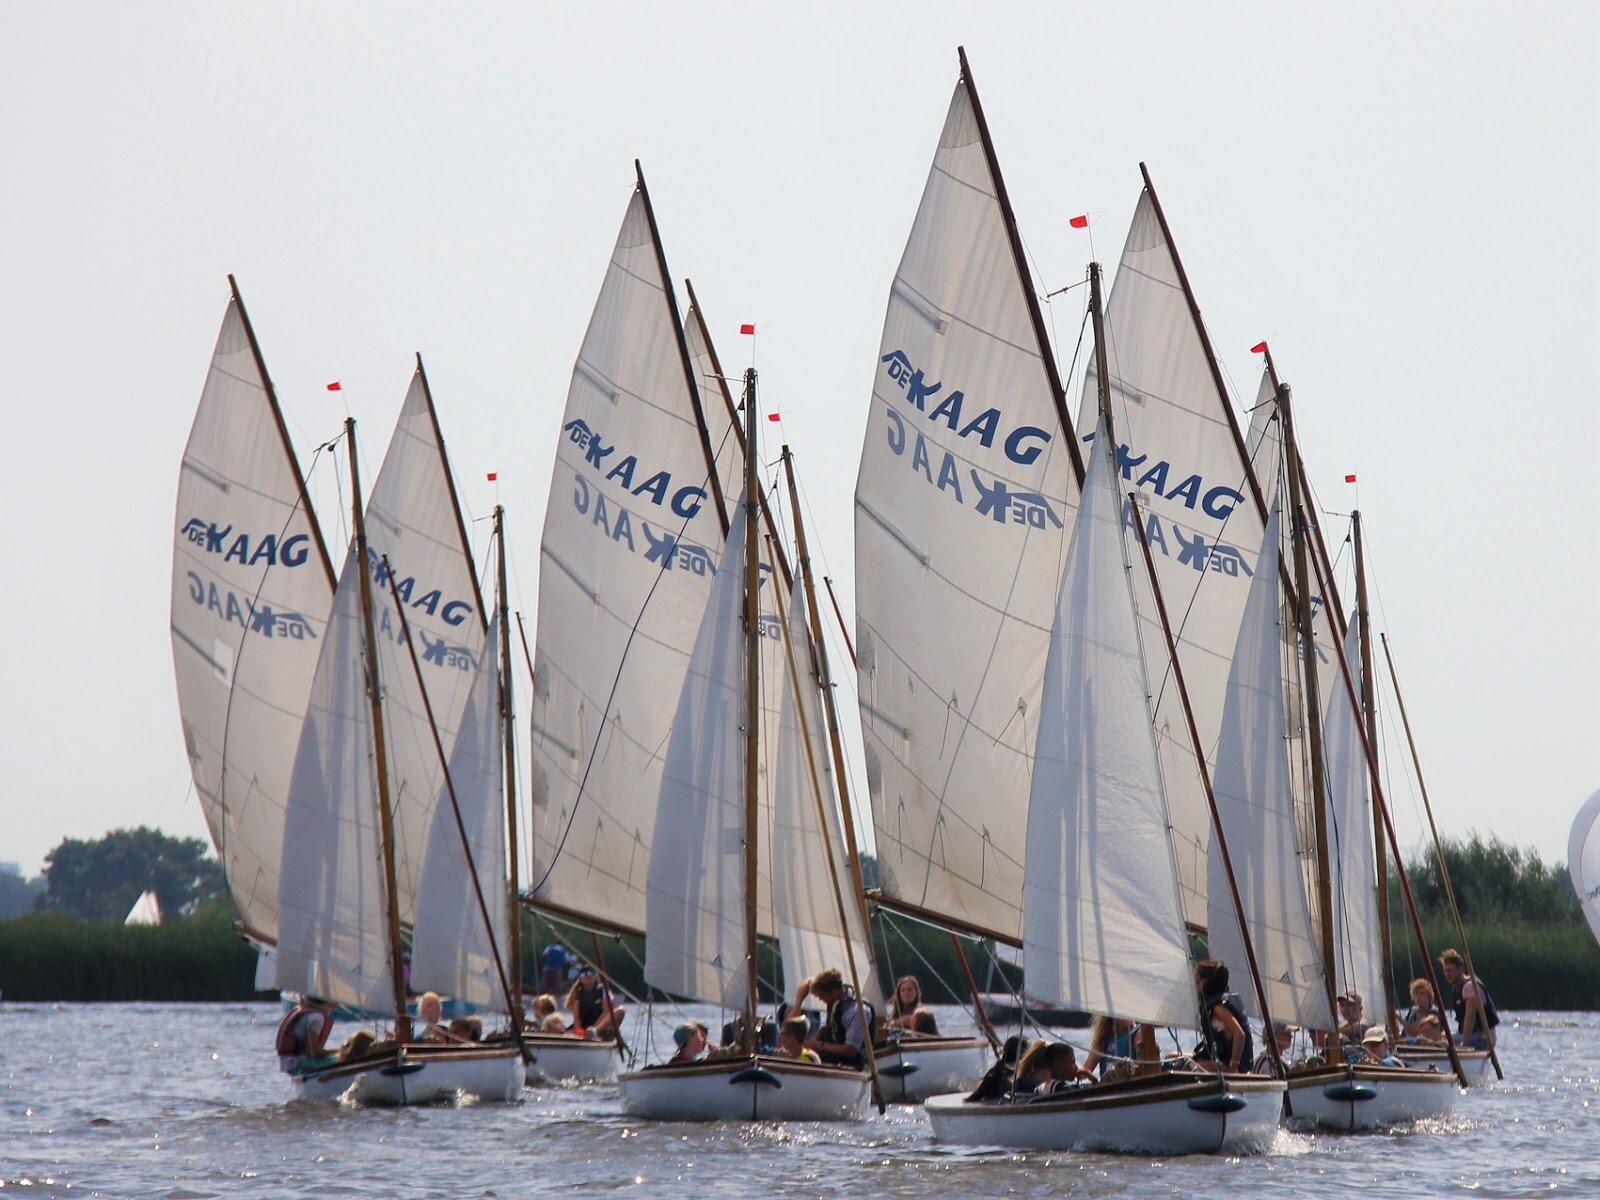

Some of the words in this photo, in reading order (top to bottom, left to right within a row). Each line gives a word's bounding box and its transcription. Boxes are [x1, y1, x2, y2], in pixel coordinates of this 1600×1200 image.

[887, 358, 910, 390] DE
[906, 368, 1052, 465] KAAG
[569, 426, 590, 450] DE
[585, 432, 708, 519] KAAG
[1116, 443, 1246, 521] KAAG
[188, 527, 204, 547] DE
[206, 522, 310, 568] KAAG
